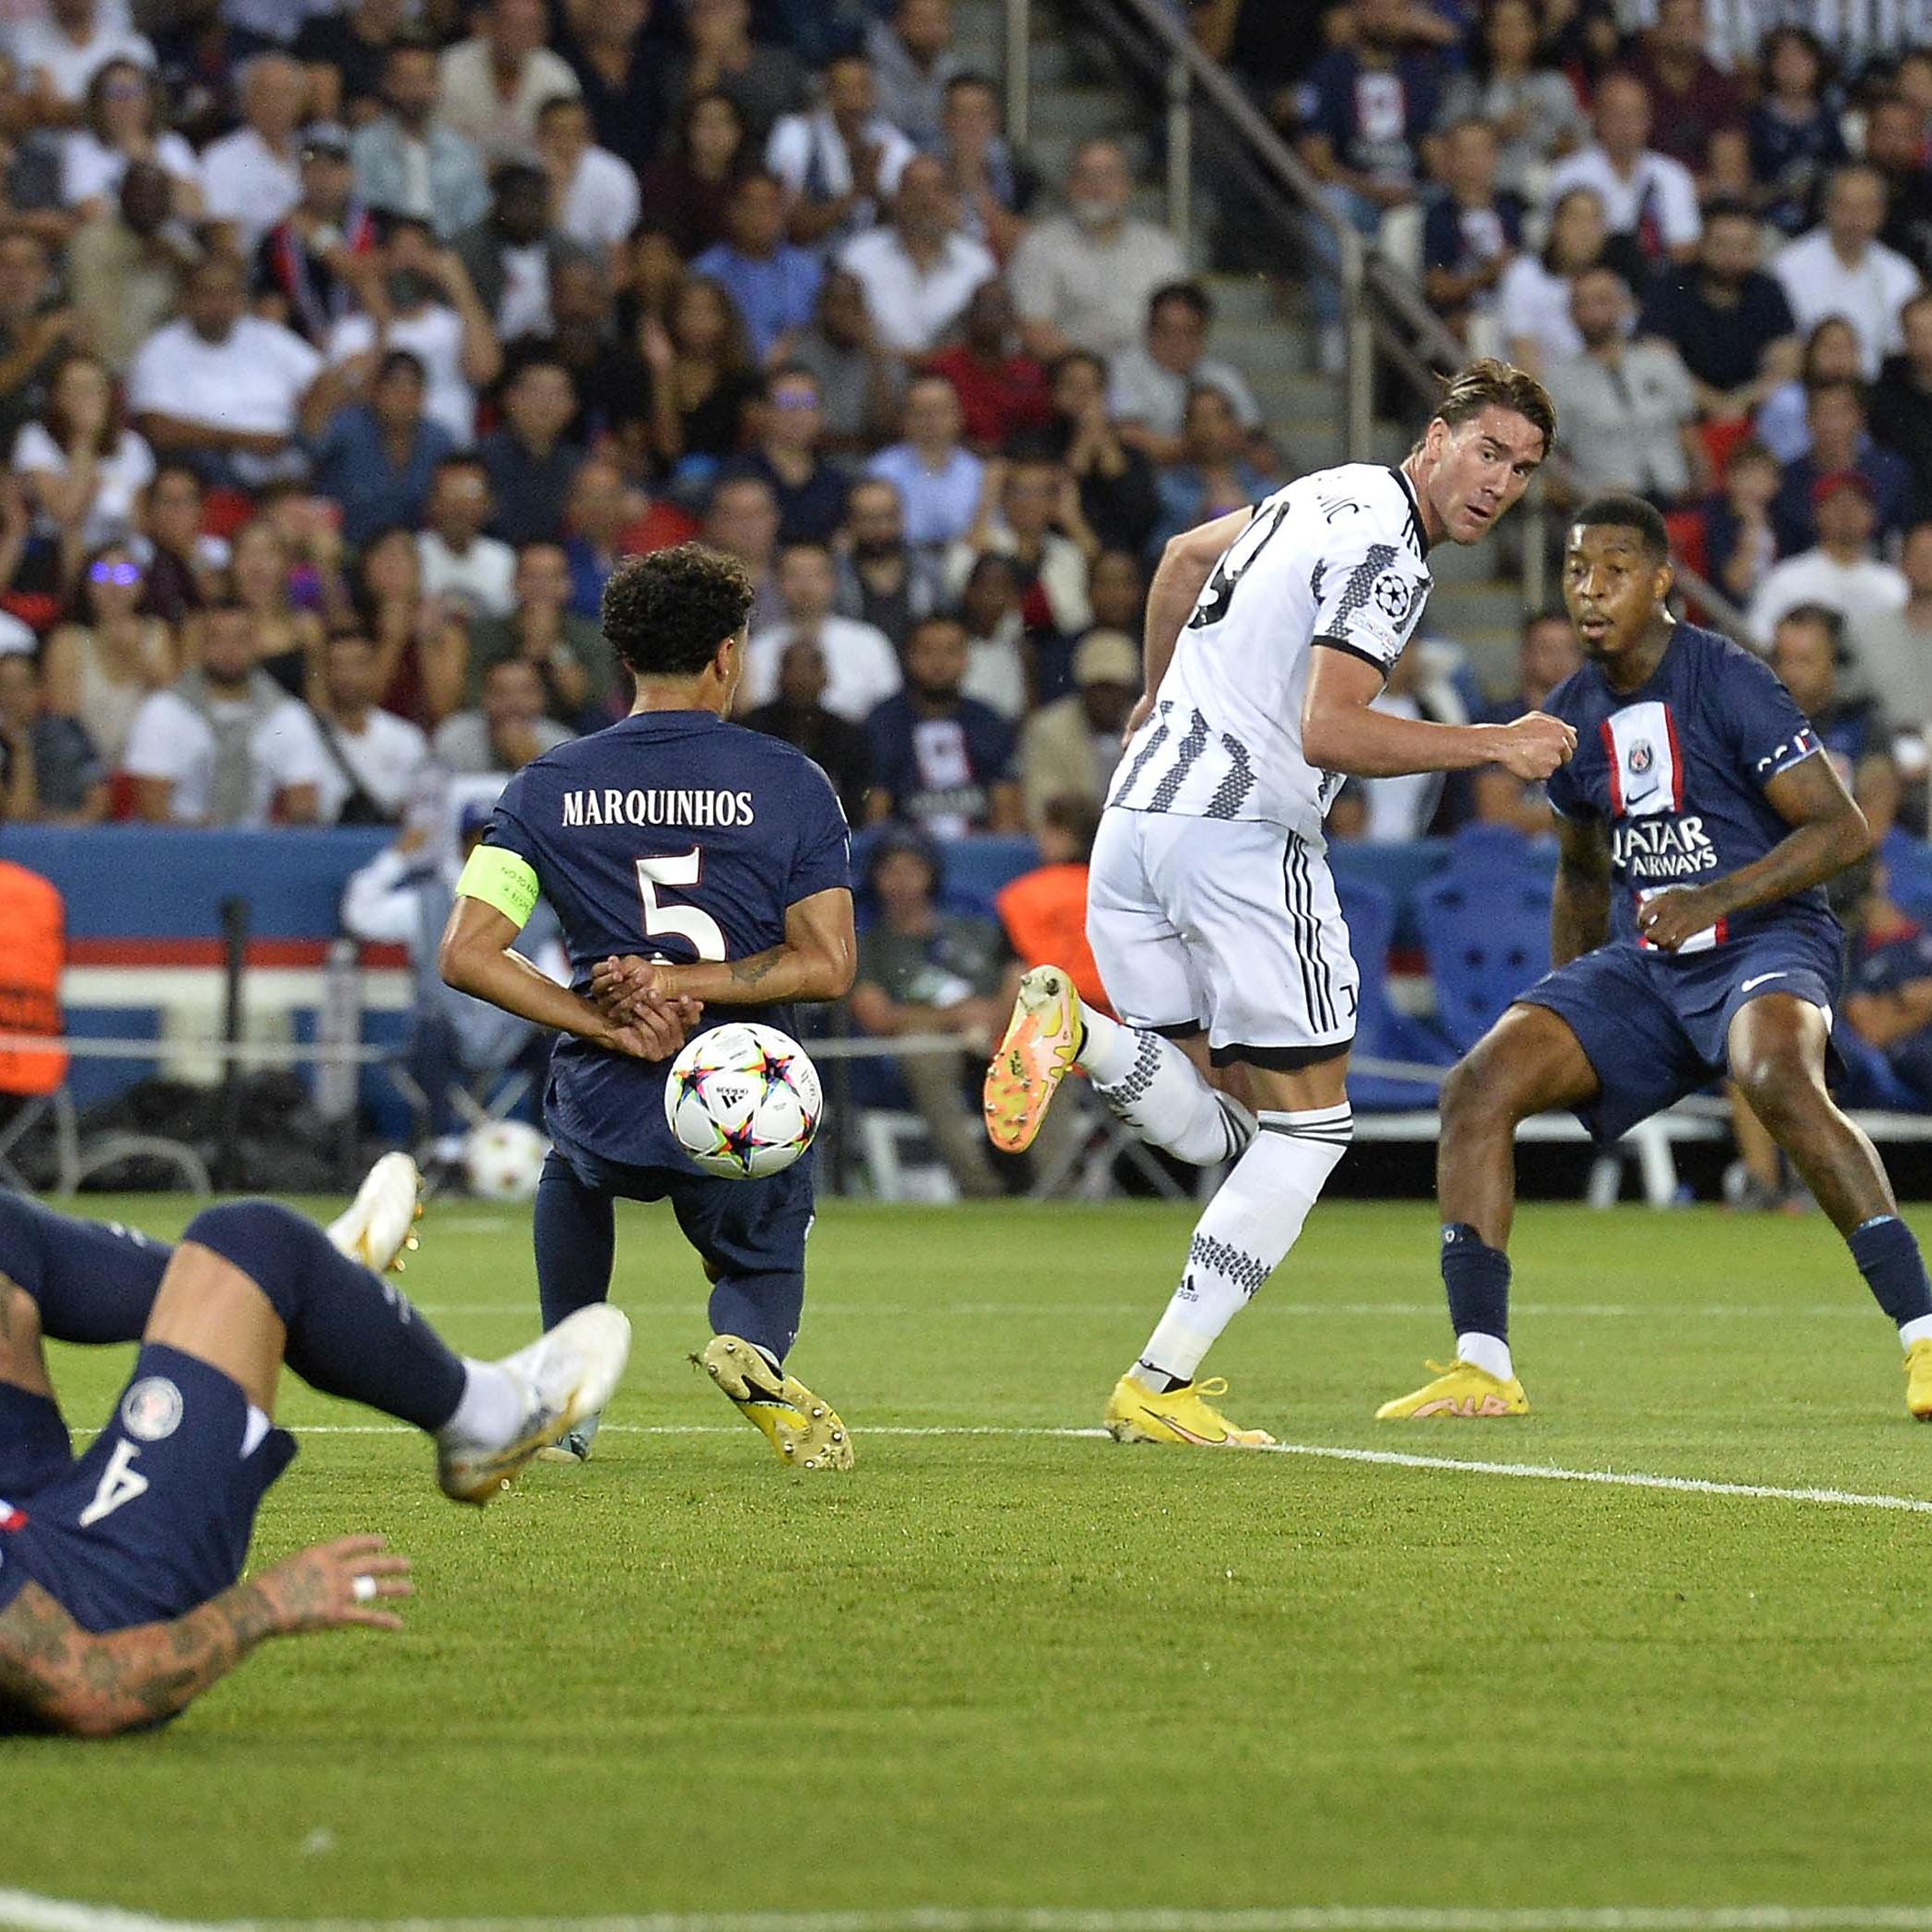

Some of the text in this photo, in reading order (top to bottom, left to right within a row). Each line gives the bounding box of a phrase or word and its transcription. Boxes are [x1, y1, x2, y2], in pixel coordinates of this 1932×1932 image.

[561, 789, 755, 827] MARQUINHOS
[1633, 845, 1718, 876] AIRWAYS
[635, 844, 729, 965] 5
[78, 1437, 149, 1528] 4
